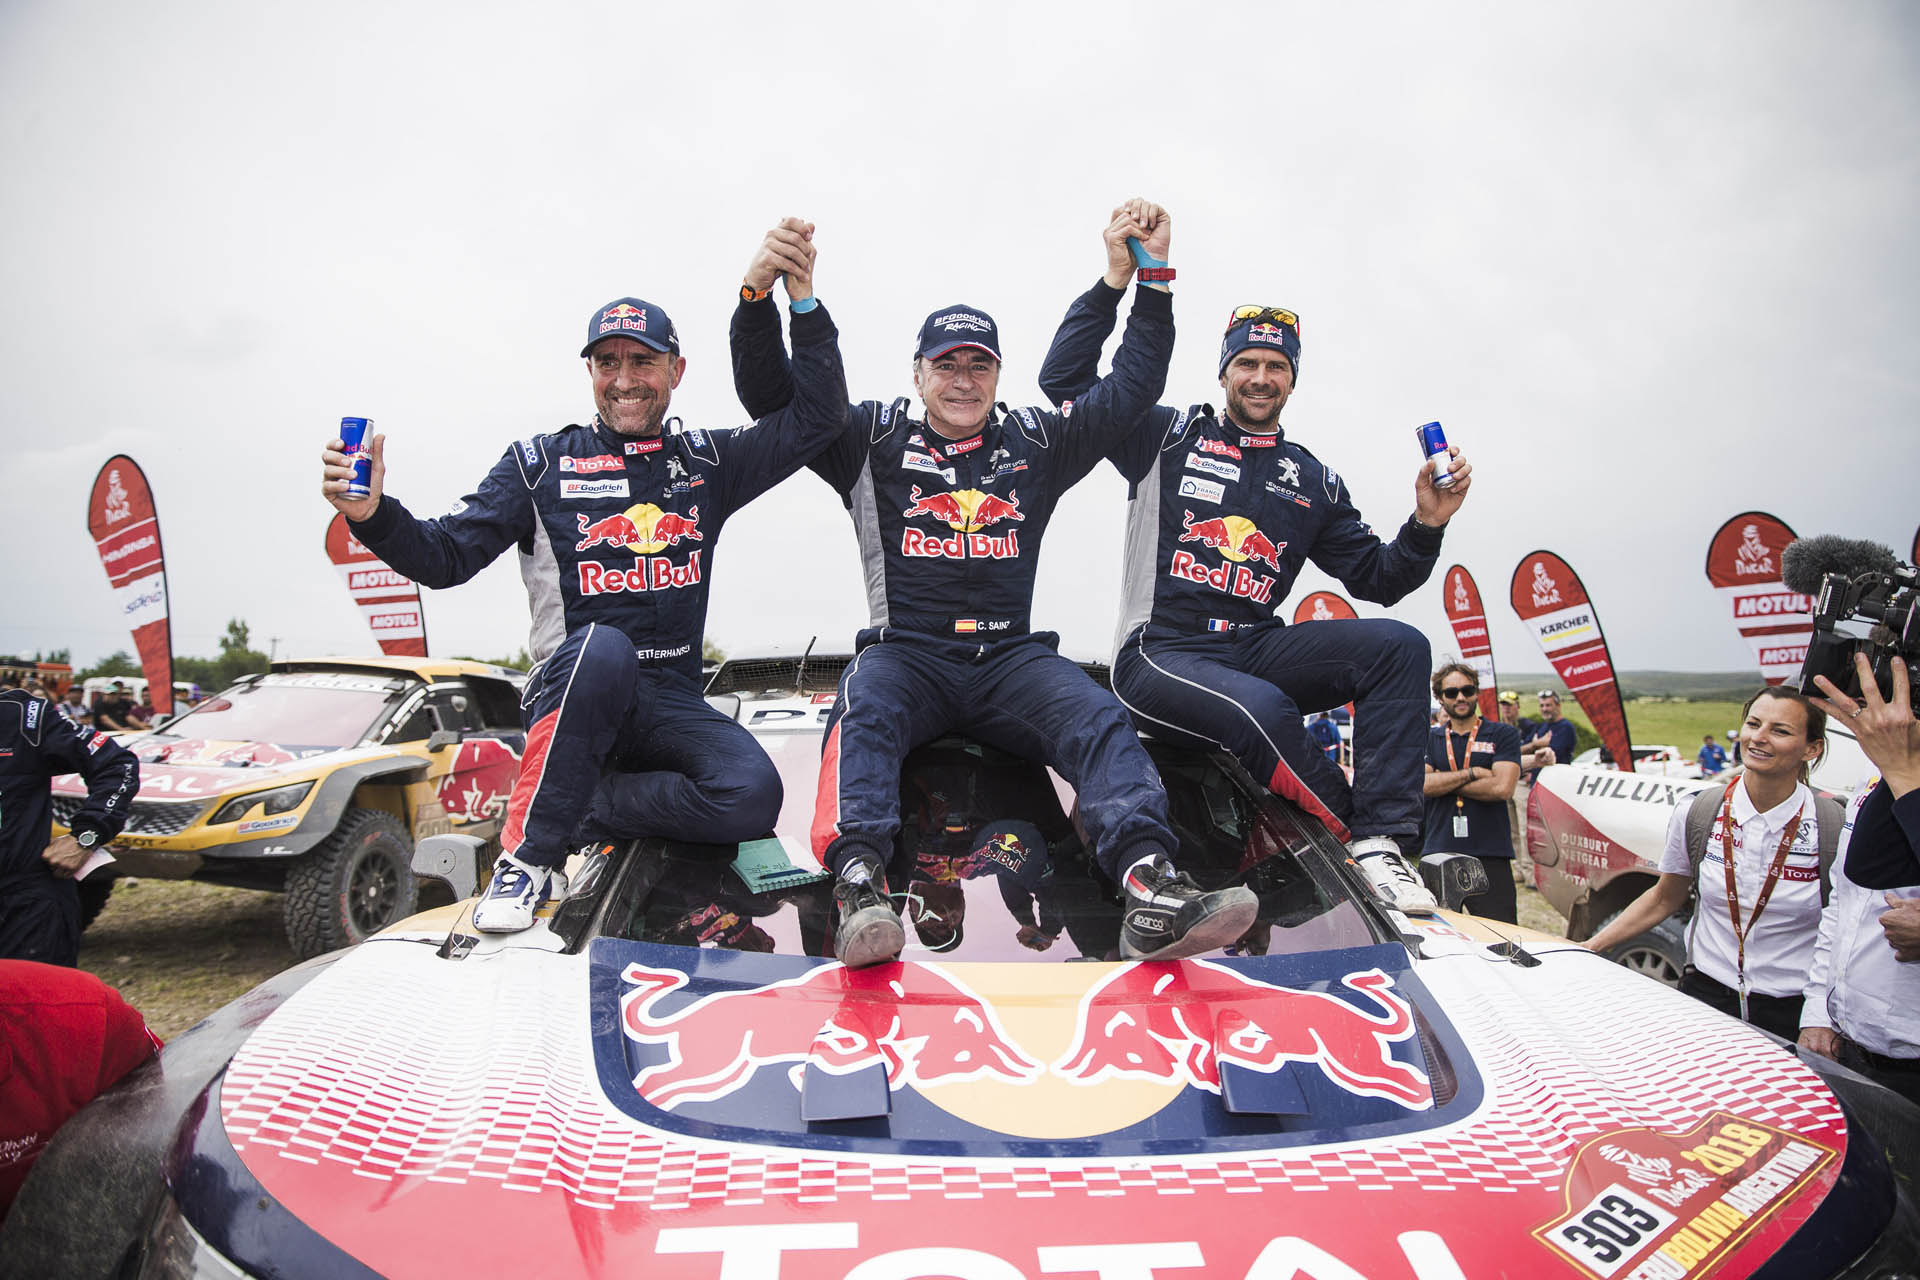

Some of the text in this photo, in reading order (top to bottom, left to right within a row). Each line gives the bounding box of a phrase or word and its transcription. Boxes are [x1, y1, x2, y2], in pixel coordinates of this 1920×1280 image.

[600, 318, 646, 333] Red Bull
[1249, 333, 1283, 346] Red Bull
[637, 442, 662, 450] TOTAL
[957, 440, 983, 451] TOTAL
[1252, 438, 1276, 446] TOTAL
[578, 459, 623, 470] TOTAL
[567, 482, 623, 492] BFGoodrich
[902, 526, 1020, 559] Red Bull
[578, 549, 702, 596] Red Bull
[1170, 549, 1277, 605] Red Bull
[1738, 596, 1809, 615] MOTUL
[373, 614, 416, 628] MOTUL
[978, 622, 987, 631] C.
[1540, 615, 1590, 635] KÄRCHER
[1762, 647, 1806, 663] MOTU
[1573, 660, 1607, 675] HONDA
[1576, 775, 1686, 806] HILUX
[1561, 832, 1610, 853] DUXBURY
[1000, 853, 1023, 873] Bull
[1560, 849, 1609, 869] NETGEAR
[1134, 914, 1164, 929] sparco
[1646, 1123, 1772, 1208] DAKAR 2018
[1658, 1199, 1749, 1272] BOLIVIA
[1720, 1141, 1825, 1219] ARGENTINA
[1561, 1194, 1660, 1264] 303
